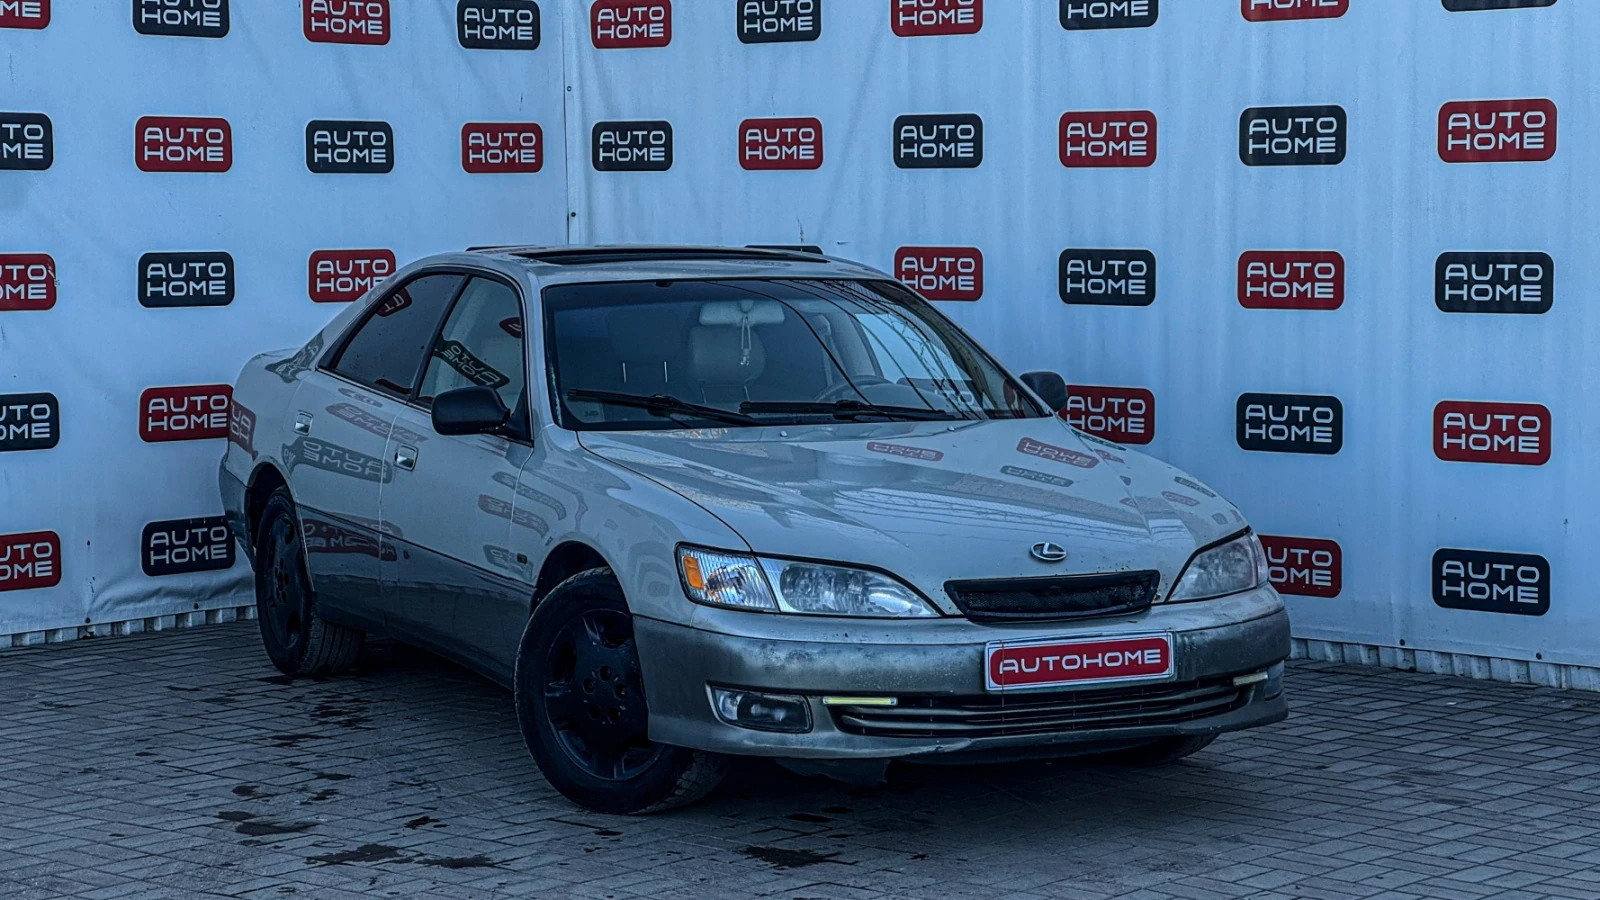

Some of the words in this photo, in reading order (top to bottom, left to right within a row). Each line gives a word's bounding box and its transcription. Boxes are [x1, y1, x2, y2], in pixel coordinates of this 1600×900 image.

[0, 1, 41, 18] ME
[310, 0, 383, 17] AUTO
[464, 8, 533, 24] AUTO
[597, 7, 665, 23] AUTO
[743, 0, 814, 16] AUTO
[1067, 0, 1149, 19] HOME
[142, 9, 219, 26] HOME
[743, 16, 813, 34] HOME
[900, 8, 974, 26] HOME
[311, 17, 383, 35] HOME
[464, 25, 533, 40] HOME
[597, 23, 664, 39] HOME
[1248, 117, 1338, 135] AUTO
[1447, 111, 1546, 131] AUTO
[0, 124, 44, 140] TO
[144, 128, 224, 144] AUTO
[313, 131, 387, 146] AUTO
[599, 131, 666, 145] AUTO
[745, 128, 815, 143] AUTO
[900, 125, 975, 140] AUTO
[1066, 122, 1148, 138] AUTO
[468, 133, 536, 147] AUTO
[1066, 140, 1147, 157] HOME
[1248, 137, 1336, 155] HOME
[1447, 131, 1545, 151] HOME
[0, 143, 44, 159] ME
[144, 146, 224, 162] HOME
[314, 148, 387, 163] HOME
[469, 149, 536, 164] HOME
[599, 147, 665, 162] HOME
[745, 145, 815, 160] HOME
[900, 143, 974, 158] HOME
[0, 265, 47, 281] TO
[147, 262, 227, 279] AUTO
[316, 259, 389, 275] AUTO
[901, 257, 976, 273] AUTO
[1066, 260, 1147, 276] AUTO
[1246, 262, 1336, 279] AUTO
[1444, 263, 1543, 281] AUTO
[147, 281, 226, 297] HOME
[901, 275, 975, 291] HOME
[1066, 278, 1146, 295] HOME
[1246, 282, 1335, 299] HOME
[0, 284, 47, 300] ME
[1444, 284, 1542, 302] HOME
[0, 404, 51, 421] TO
[148, 394, 228, 414] AUTO
[1067, 395, 1146, 415] AUTO
[148, 412, 227, 432] HOME
[1067, 413, 1145, 433] HOME
[1245, 405, 1334, 424] AUTO
[1443, 412, 1541, 433] AUTO
[0, 423, 50, 440] ME
[1245, 423, 1333, 443] HOME
[1443, 432, 1540, 454] HOME
[150, 526, 228, 548] AUTO
[150, 543, 228, 565] HOME
[1267, 546, 1333, 567] UTO
[1268, 566, 1332, 587] OME
[1442, 560, 1540, 583] AUTO
[1442, 579, 1539, 604] HOME
[999, 648, 1162, 675] AUTOHOME
